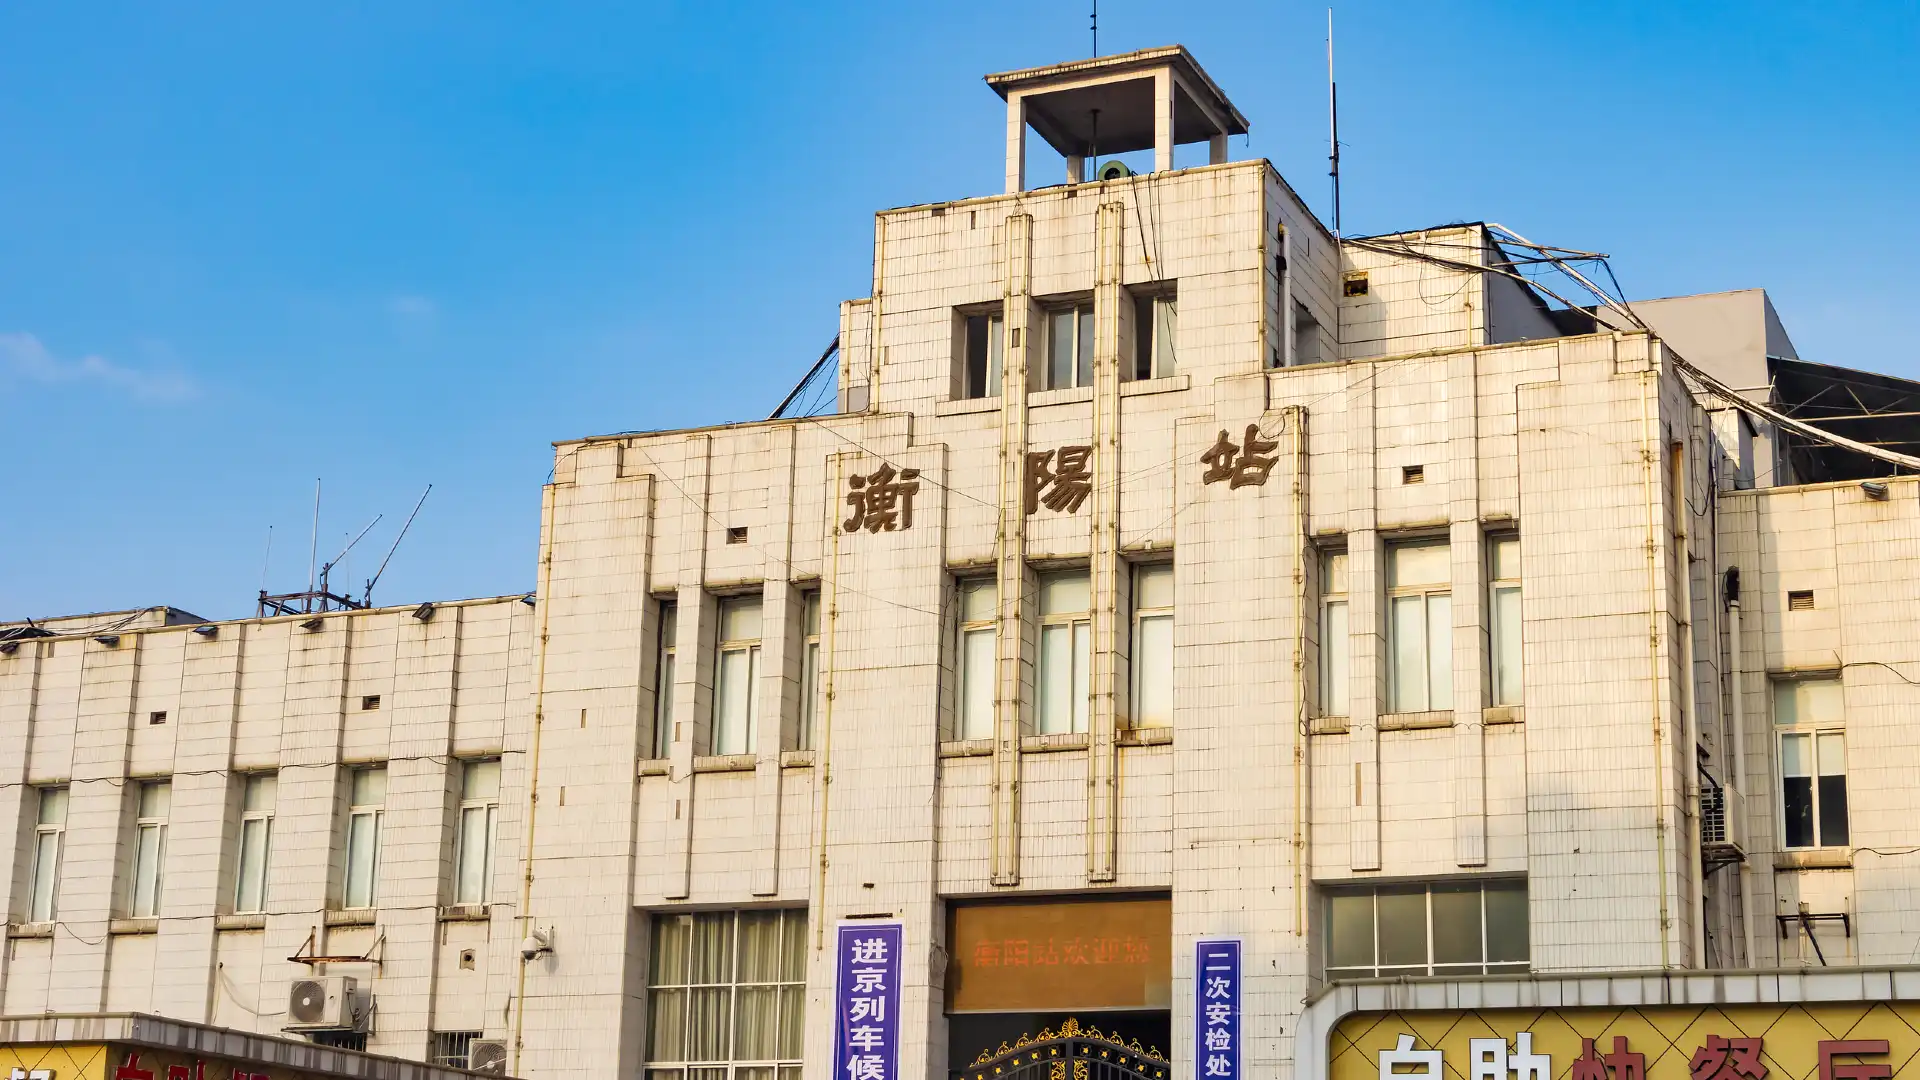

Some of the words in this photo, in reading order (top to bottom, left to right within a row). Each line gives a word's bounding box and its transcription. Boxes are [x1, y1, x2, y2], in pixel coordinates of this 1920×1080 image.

[846, 938, 888, 1080] 进京列车候
[1205, 953, 1231, 1076] 二次安检处
